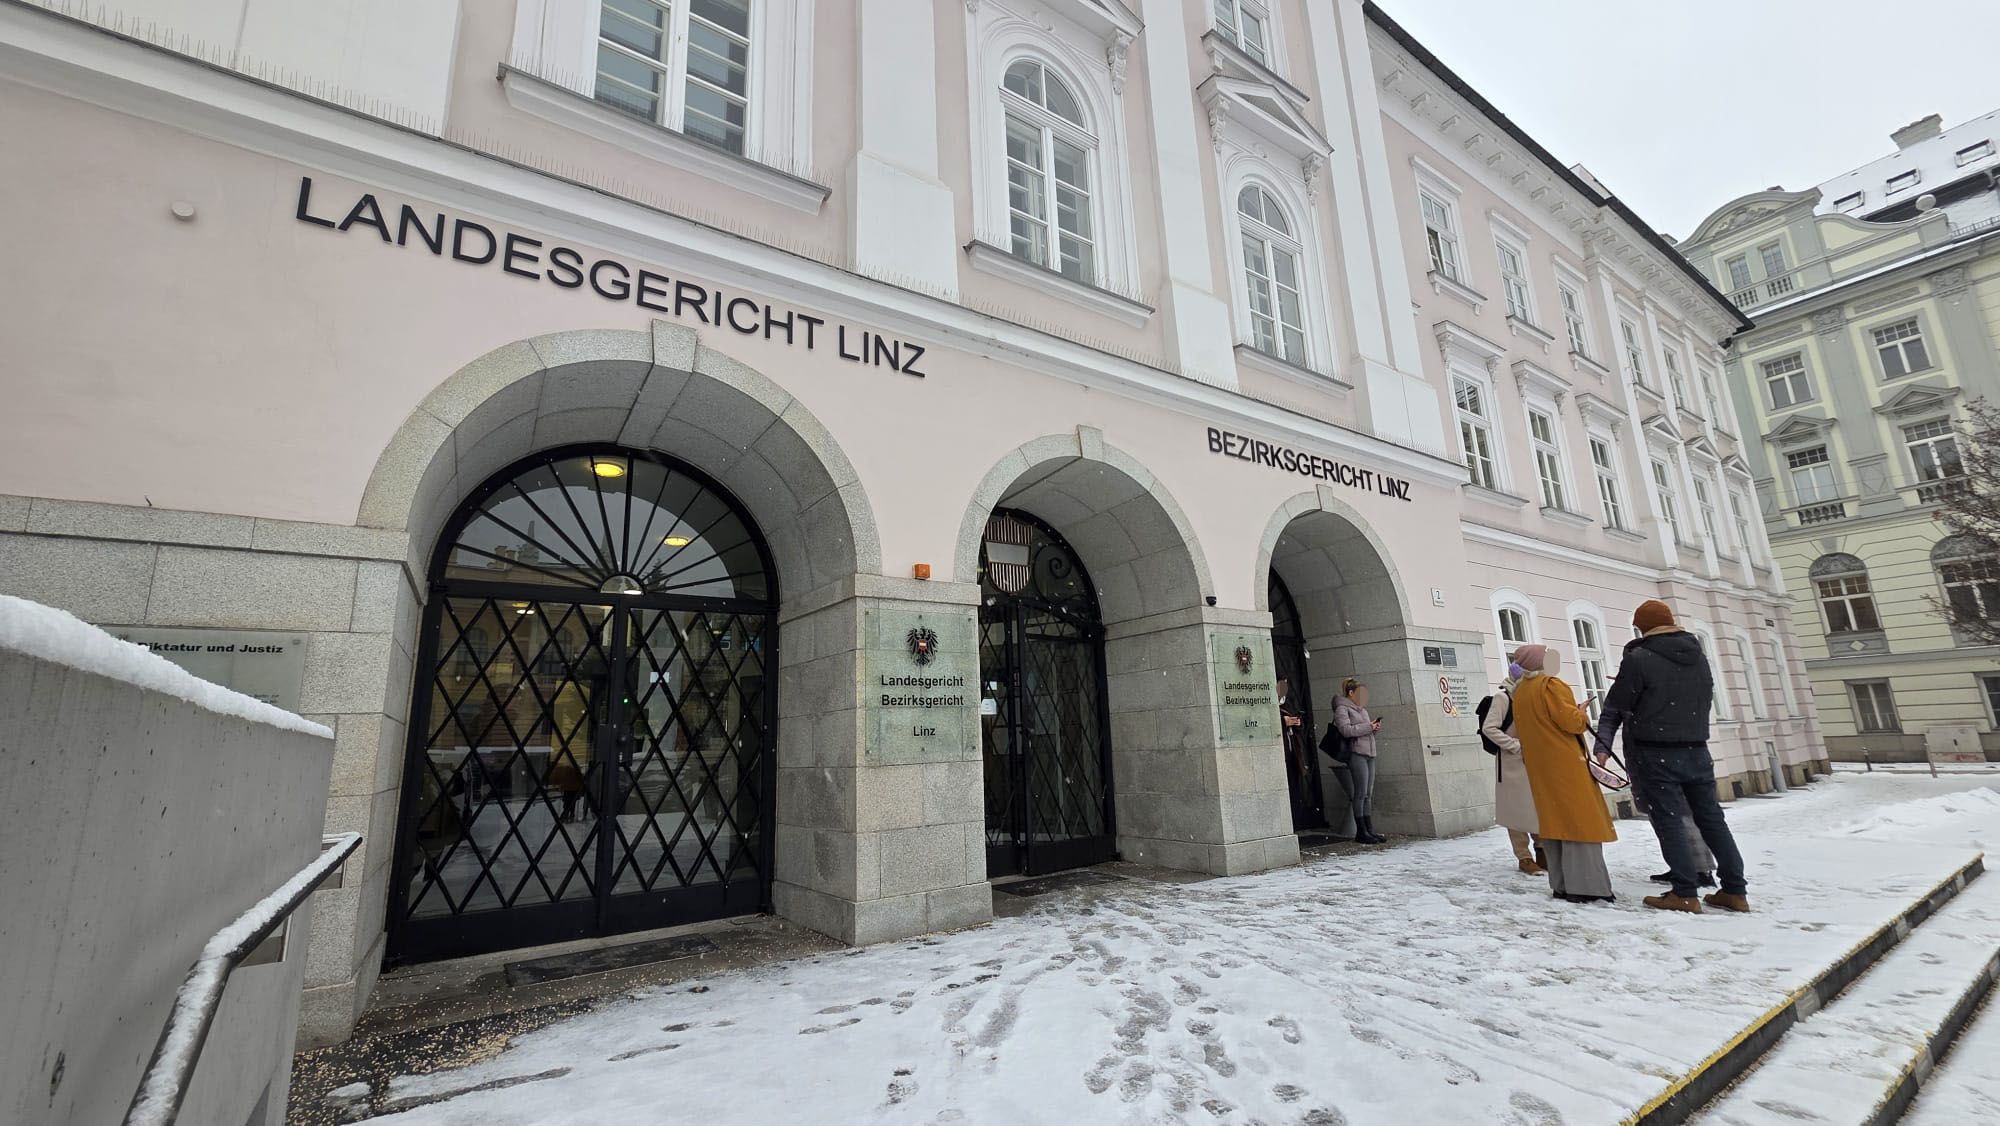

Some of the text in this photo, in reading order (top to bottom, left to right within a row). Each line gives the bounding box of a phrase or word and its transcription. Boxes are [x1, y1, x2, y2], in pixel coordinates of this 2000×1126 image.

[296, 176, 926, 378] LANDESGERICHT LINZ
[1207, 426, 1412, 502] BEZIRKSGERICHT LINZ
[206, 644, 235, 653] und
[239, 644, 284, 654] Justiz
[881, 674, 963, 689] Landesgericht
[1224, 681, 1270, 692] Landesgericht
[881, 694, 964, 709] Bezirksgericht
[1226, 695, 1272, 706] Bezirksgericht
[1244, 719, 1258, 728] Linz
[913, 725, 936, 736] Linz
